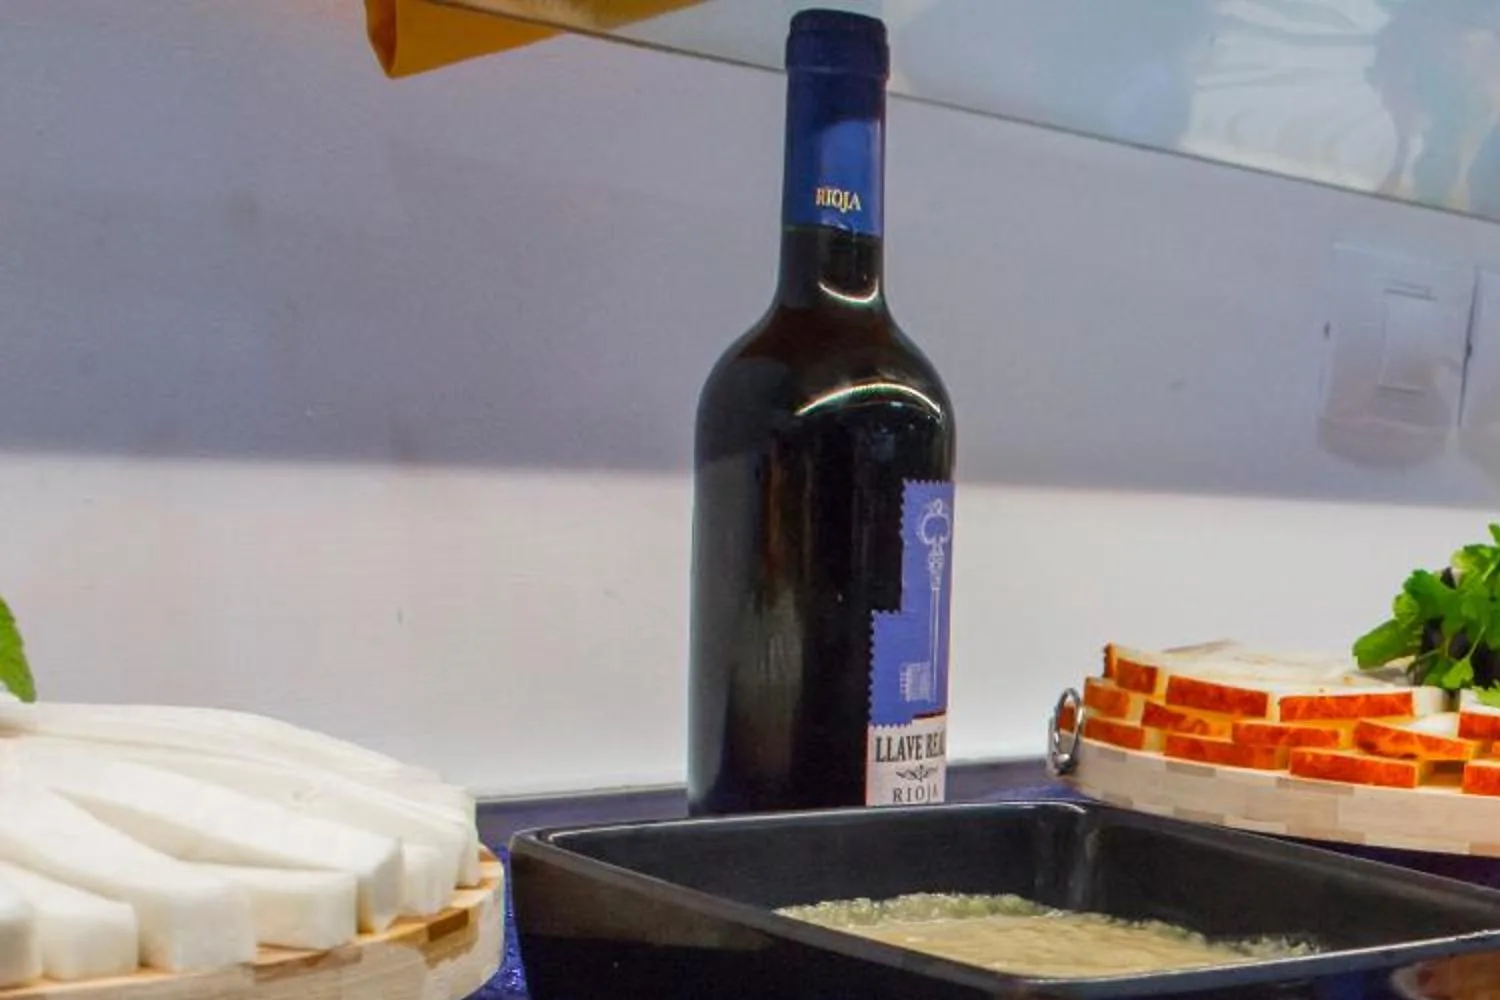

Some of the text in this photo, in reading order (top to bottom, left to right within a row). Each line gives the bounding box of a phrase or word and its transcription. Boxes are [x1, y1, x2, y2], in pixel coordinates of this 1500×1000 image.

[815, 187, 862, 213] RIOJA
[875, 735, 923, 763] LLAVE
[892, 783, 939, 803] RIOJA
